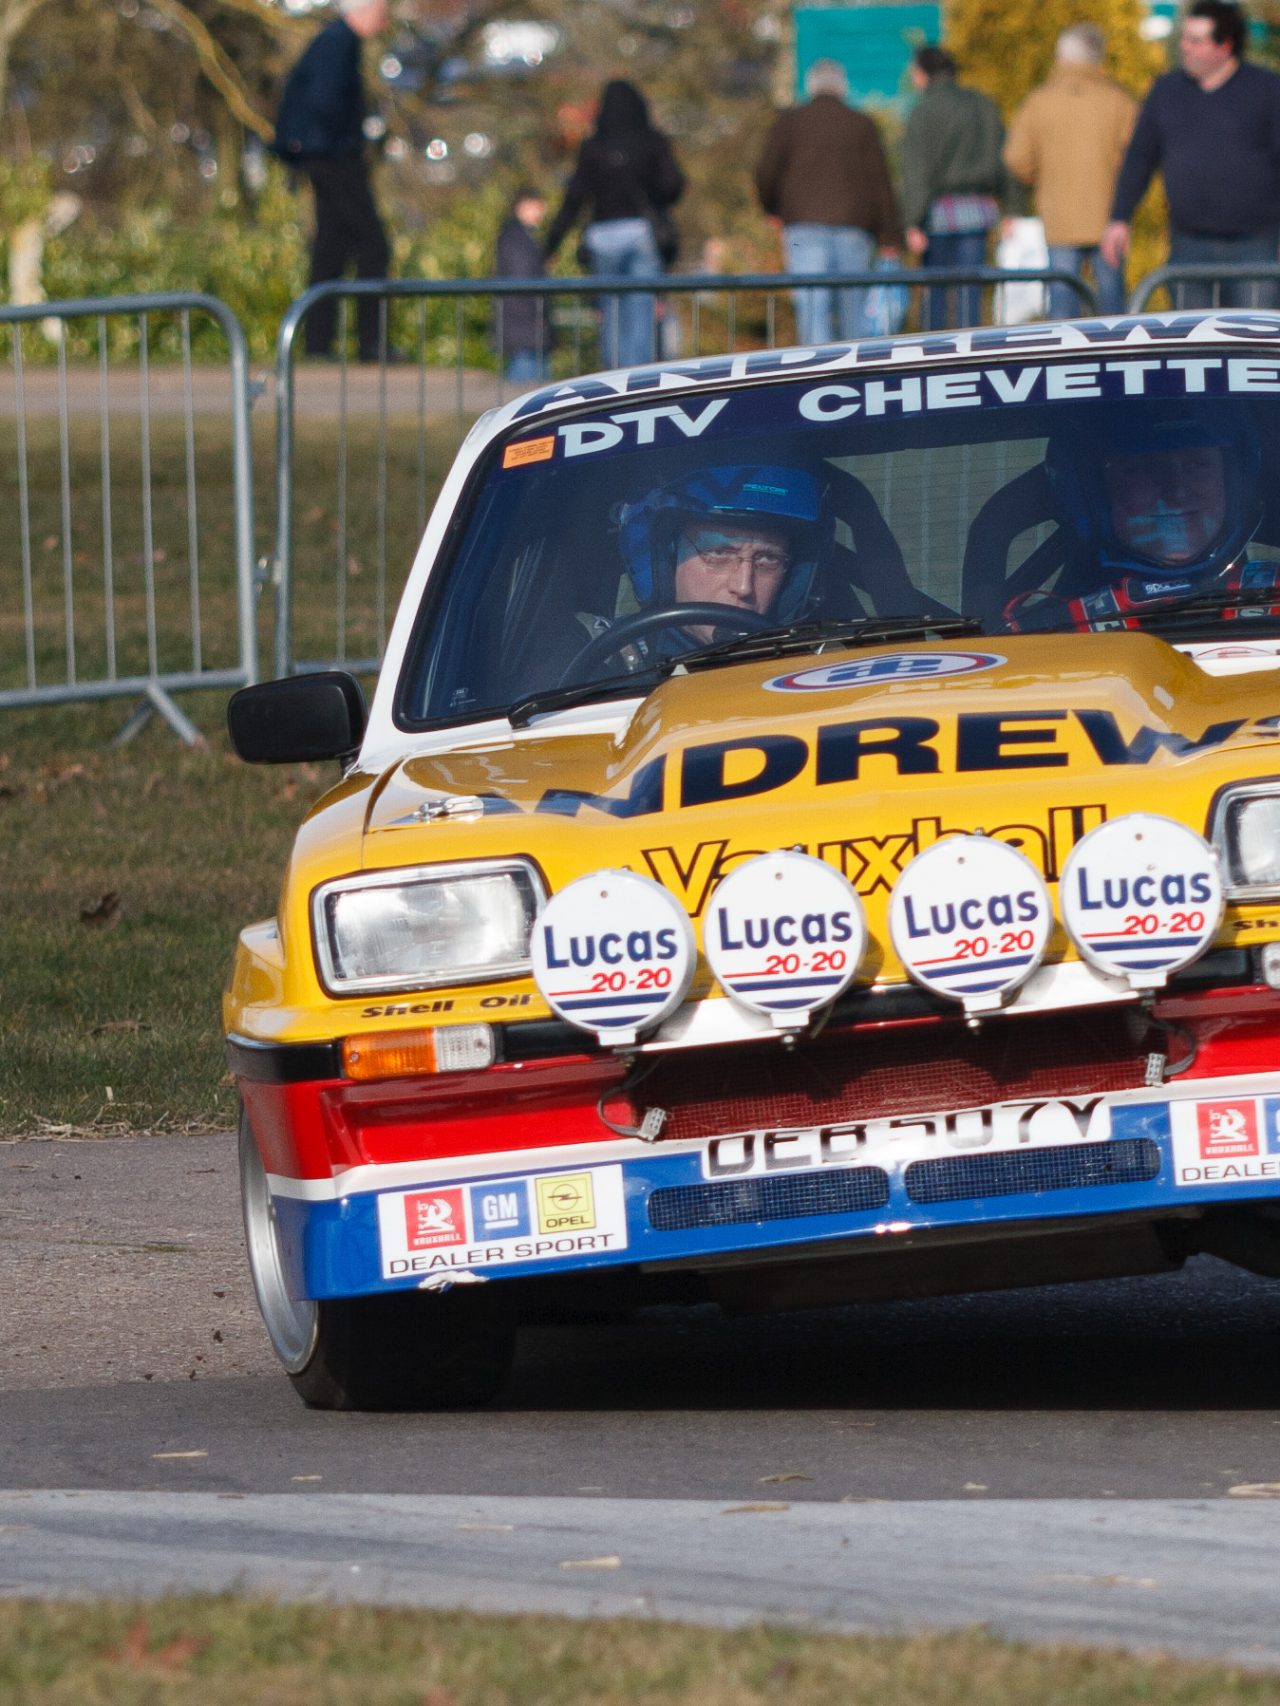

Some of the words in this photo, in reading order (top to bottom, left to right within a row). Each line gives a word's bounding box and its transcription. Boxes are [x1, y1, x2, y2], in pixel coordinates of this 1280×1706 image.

[558, 398, 730, 458] DTV
[1076, 866, 1213, 911] Lucas
[718, 907, 853, 951] Lucas
[903, 890, 1039, 939] Lucas
[1124, 911, 1205, 935] 20-20
[543, 925, 678, 969] Lucas
[954, 929, 1034, 960] 20-20
[765, 949, 847, 975] 20-20
[591, 966, 673, 993] 20-20
[361, 1000, 455, 1018] Shell
[480, 993, 532, 1008] Oil
[482, 1193, 518, 1221] GM
[546, 1215, 590, 1229] OPEL
[390, 1247, 504, 1275] DEALER
[514, 1233, 615, 1258] SPORT
